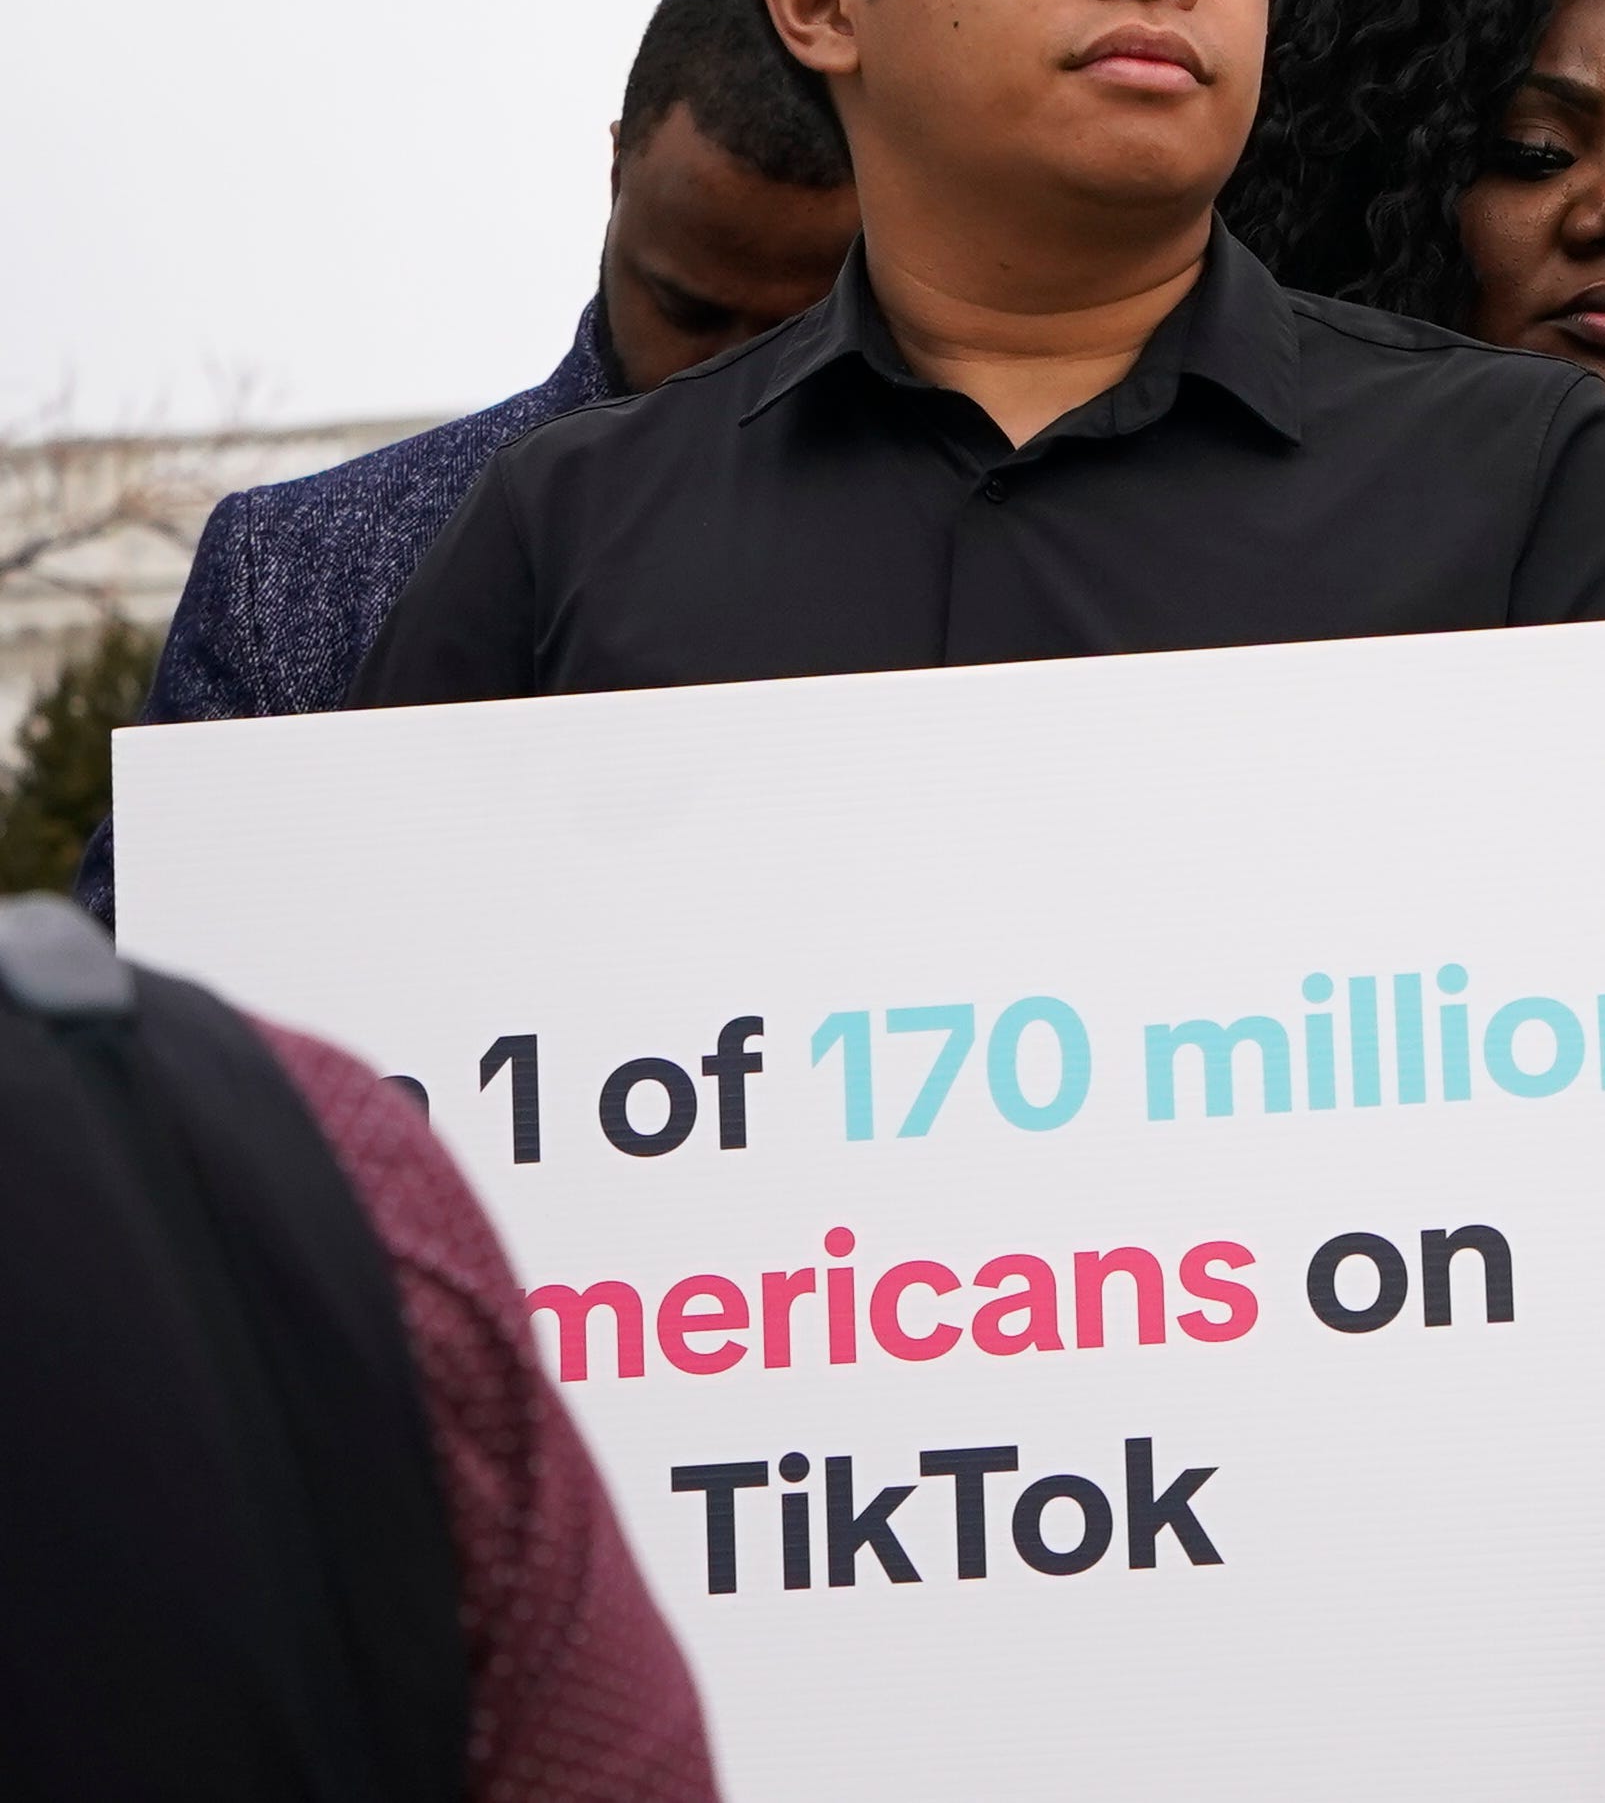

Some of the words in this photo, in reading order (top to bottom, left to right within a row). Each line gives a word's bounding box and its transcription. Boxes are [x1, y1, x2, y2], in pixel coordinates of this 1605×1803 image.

[479, 1033, 541, 1164] 1
[599, 1016, 764, 1158] of
[812, 996, 1092, 1142] 170
[517, 1226, 1258, 1382] mericans
[1306, 1224, 1515, 1334] on
[671, 1437, 1225, 1595] TikTok
